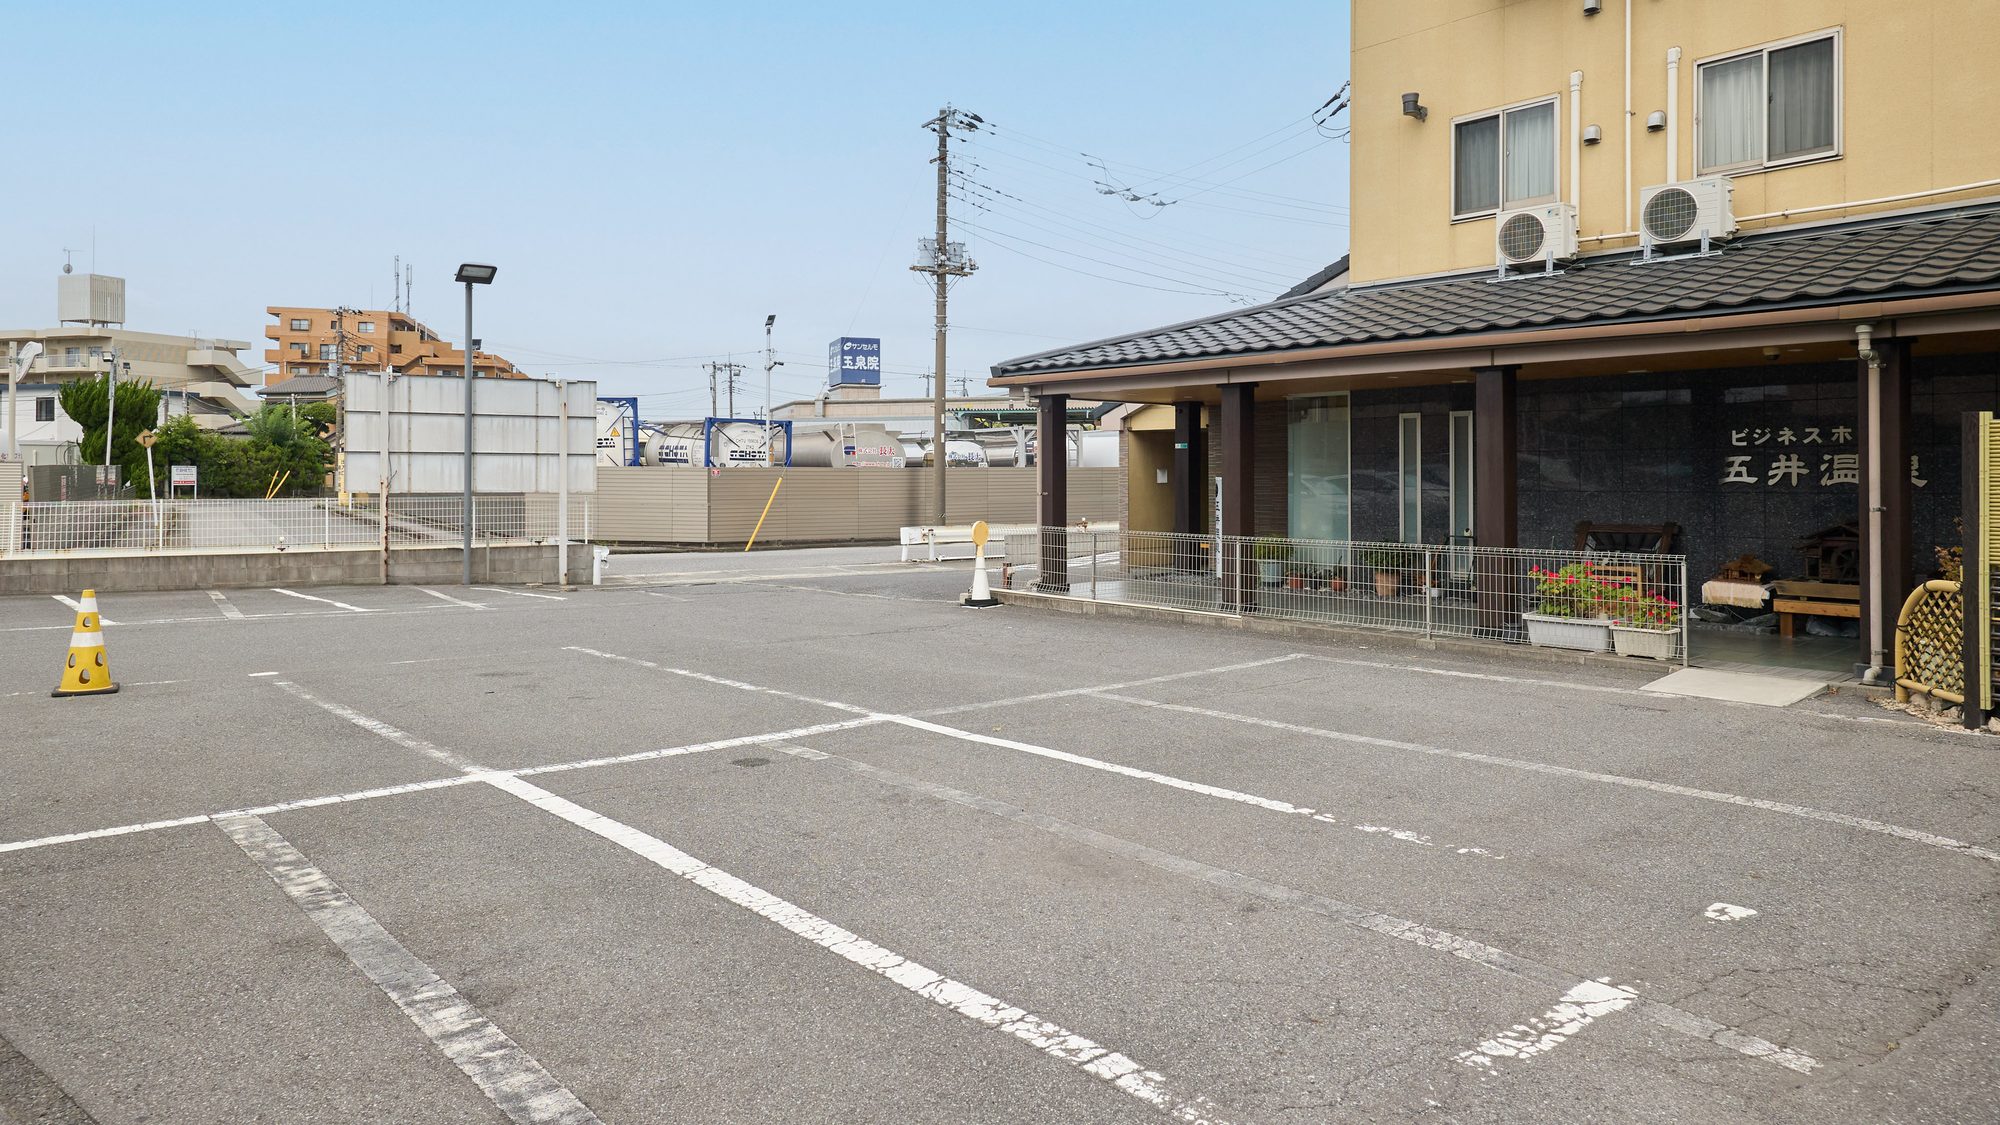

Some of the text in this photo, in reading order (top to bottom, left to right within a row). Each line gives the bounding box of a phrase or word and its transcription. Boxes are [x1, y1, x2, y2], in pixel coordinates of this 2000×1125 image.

[842, 355, 880, 370] 玉泉院
[1731, 426, 1853, 446] ビジネスホ
